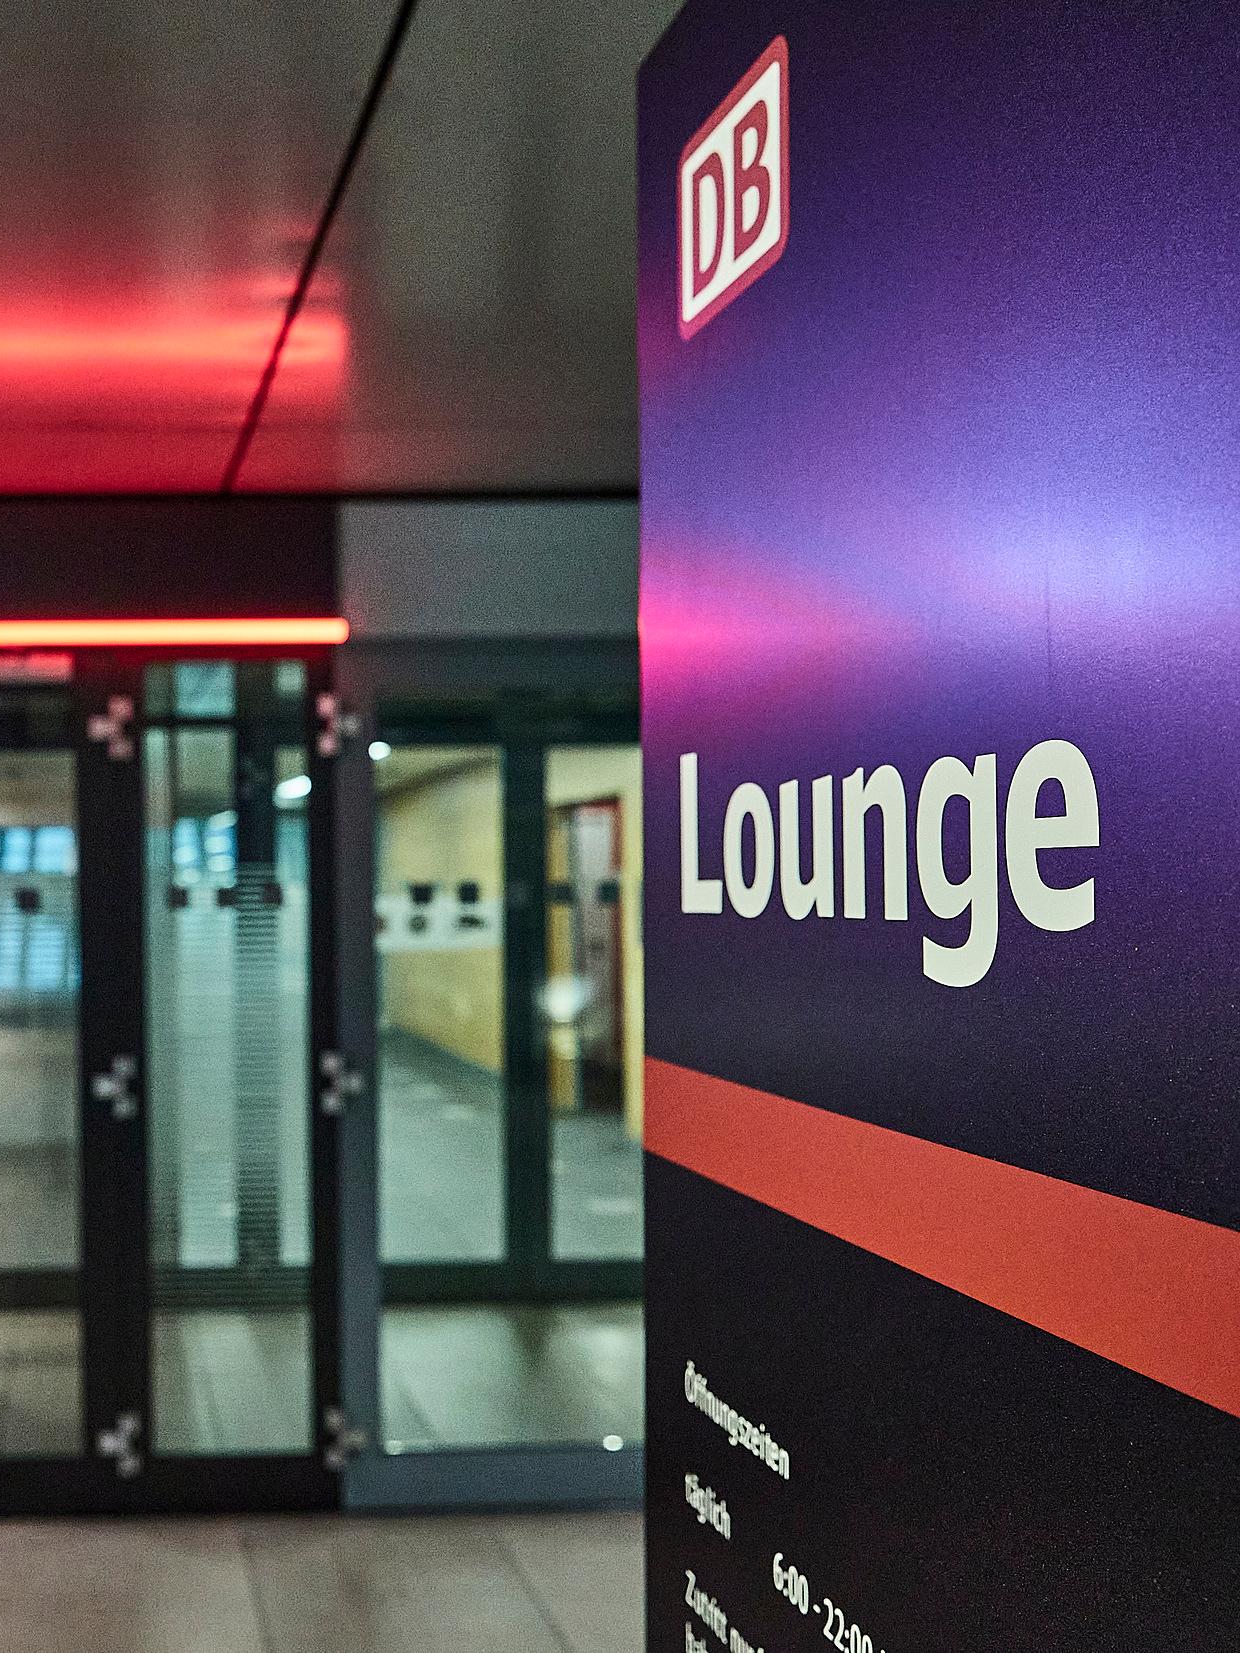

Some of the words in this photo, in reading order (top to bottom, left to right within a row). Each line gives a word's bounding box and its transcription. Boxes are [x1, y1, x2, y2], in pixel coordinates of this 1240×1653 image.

[692, 99, 771, 299] DB
[680, 739, 1100, 987] Lounge
[685, 1360, 790, 1480] Öffnungszeiten
[685, 1473, 731, 1540] täglich
[772, 1552, 809, 1615] 6:00
